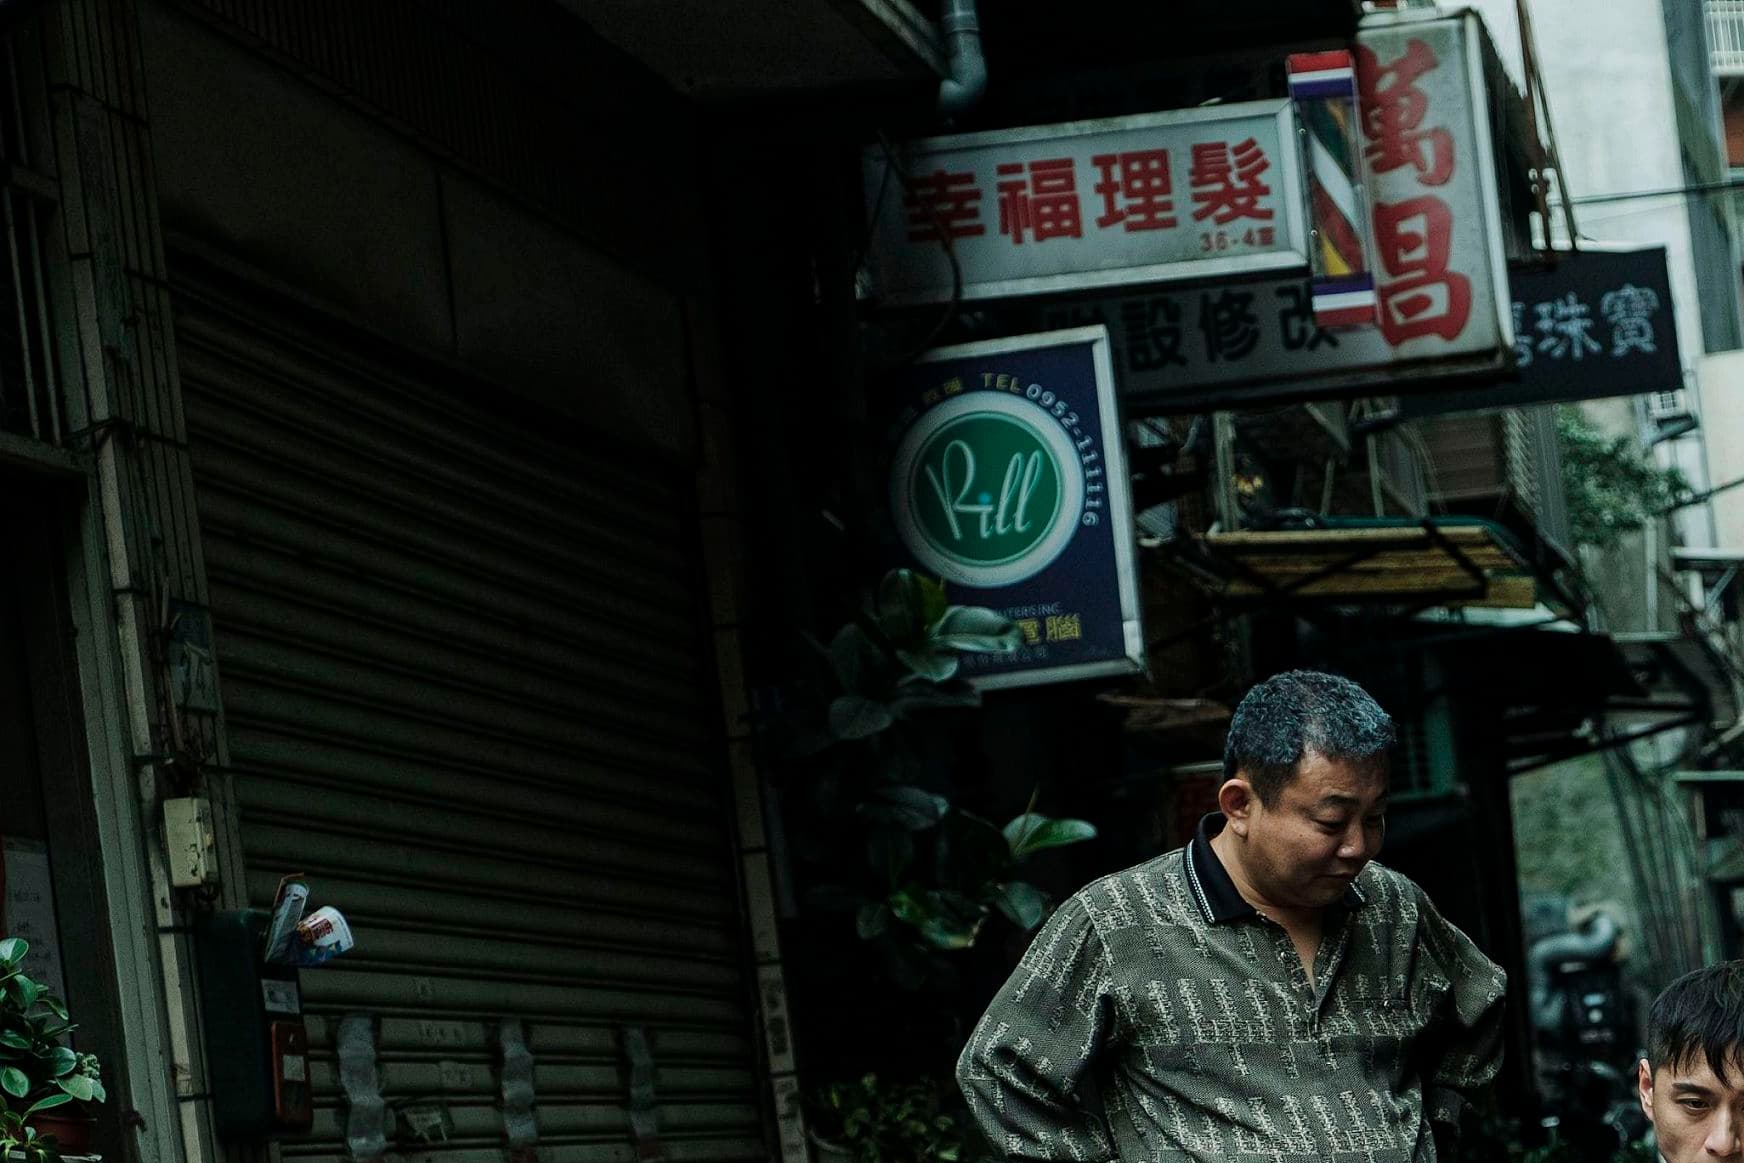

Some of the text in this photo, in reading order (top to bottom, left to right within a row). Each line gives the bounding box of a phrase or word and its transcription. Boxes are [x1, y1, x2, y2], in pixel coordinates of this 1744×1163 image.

[904, 137, 1273, 245] 幸福理髮
[1355, 38, 1473, 348] 萬昌
[979, 371, 1024, 395] TEL
